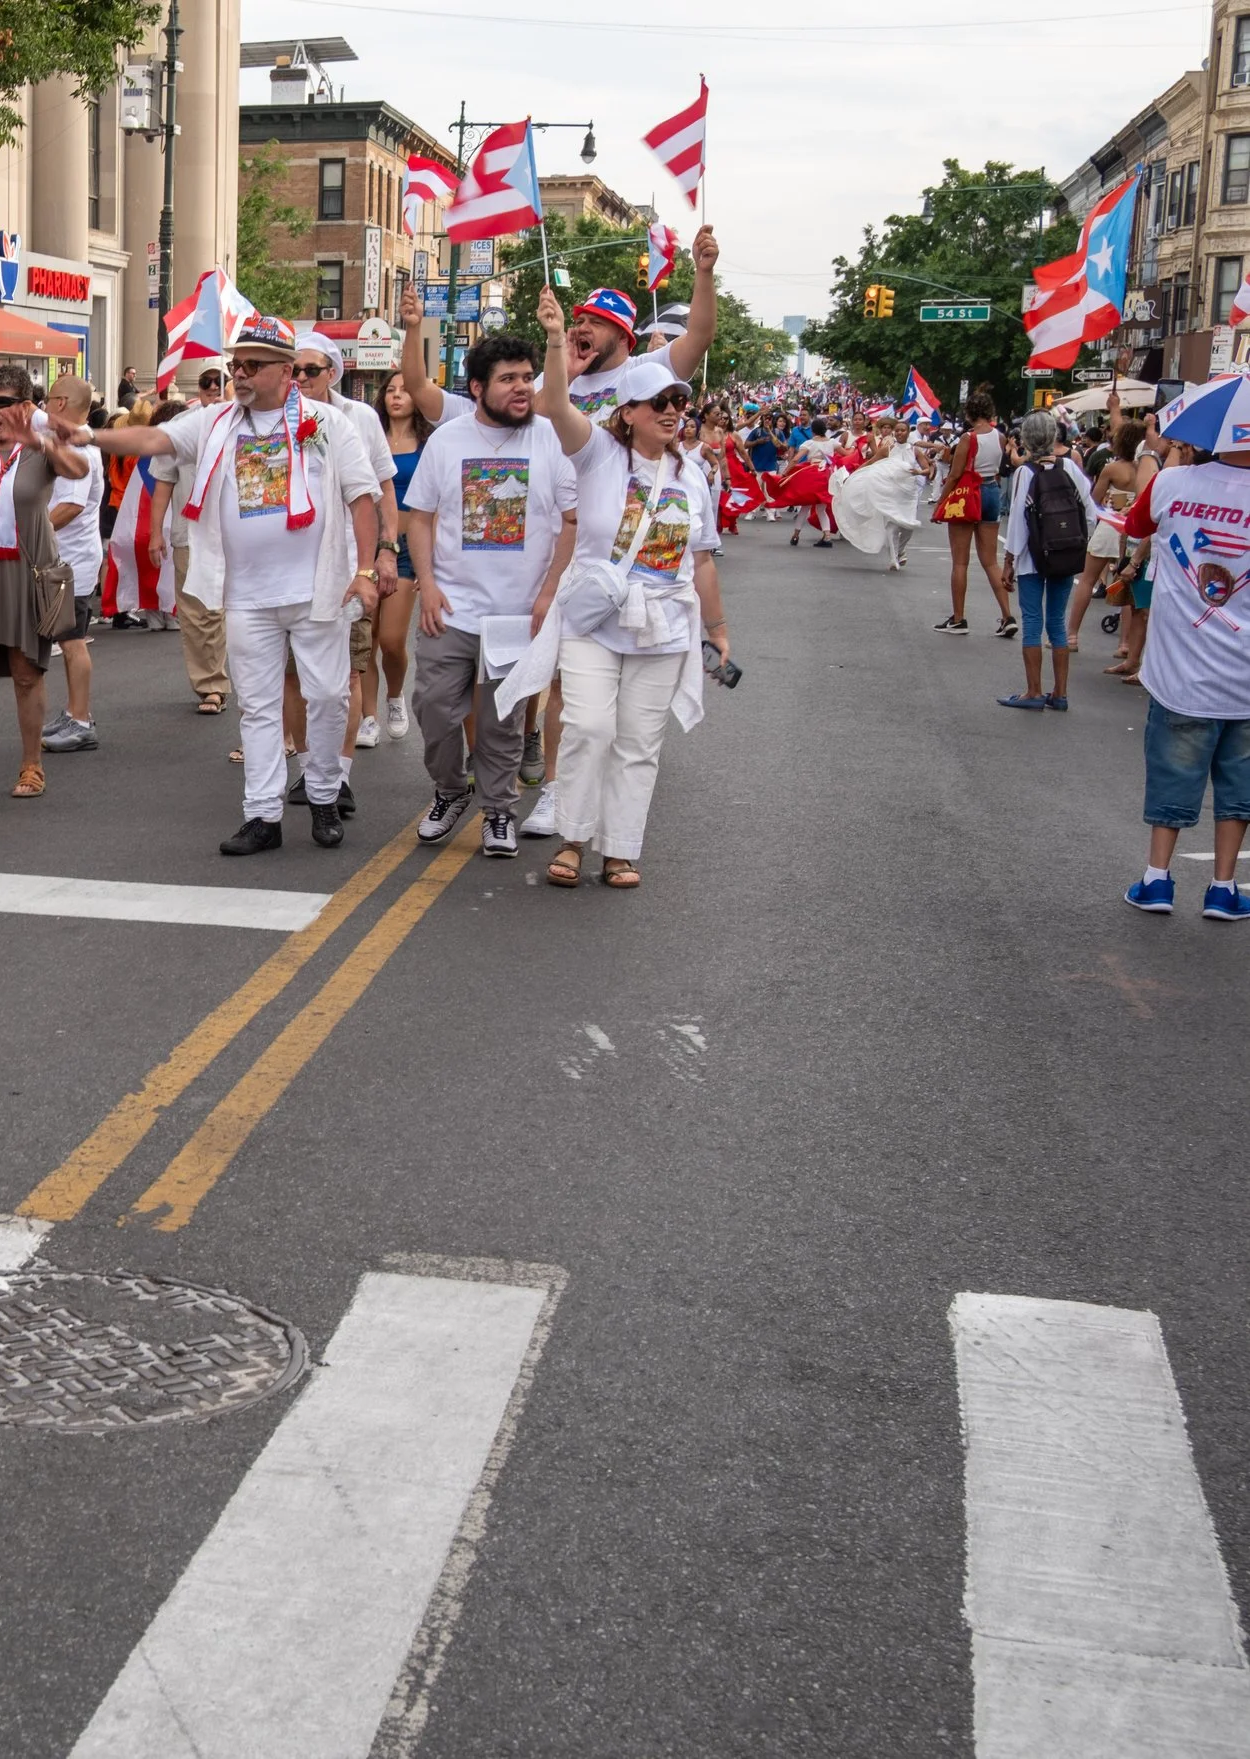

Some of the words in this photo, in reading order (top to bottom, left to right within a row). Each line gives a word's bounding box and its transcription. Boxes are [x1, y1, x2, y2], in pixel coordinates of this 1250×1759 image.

[367, 232, 379, 304] BAKERY
[28, 266, 92, 302] PHARMACY
[937, 309, 954, 318] 54
[958, 309, 973, 318] St
[1079, 372, 1090, 380] ONE
[1168, 499, 1244, 524] PUERTO
